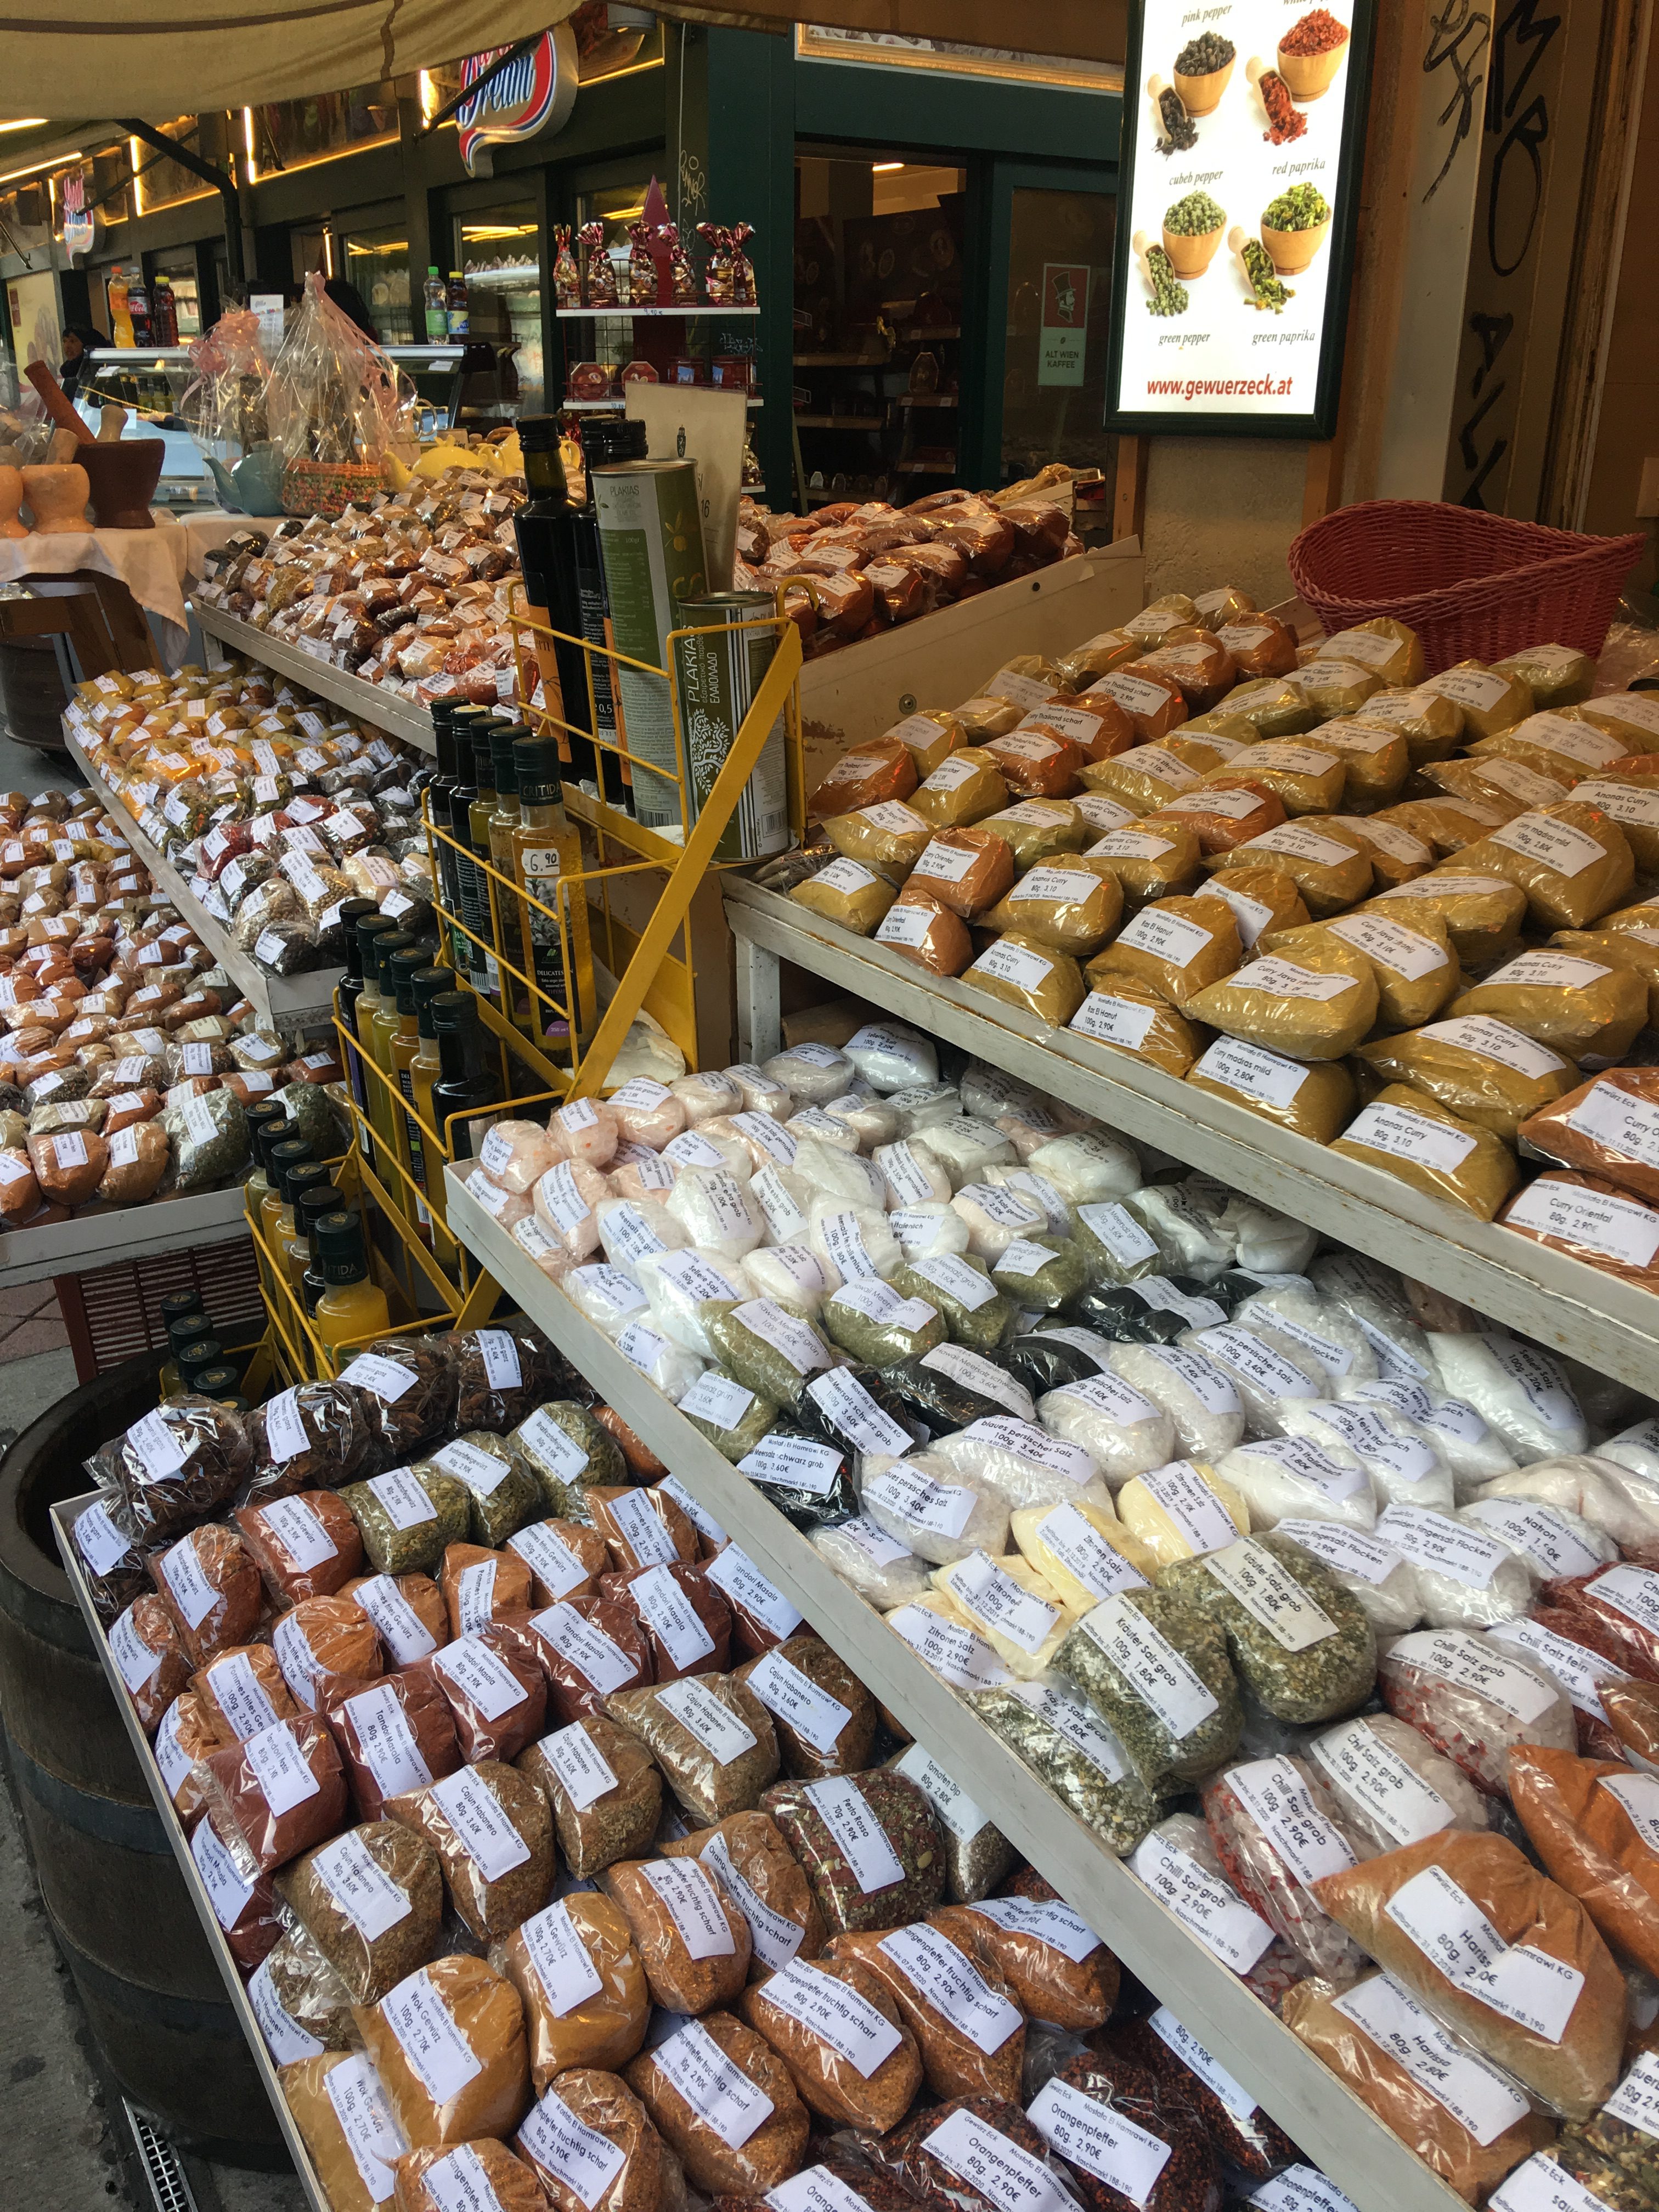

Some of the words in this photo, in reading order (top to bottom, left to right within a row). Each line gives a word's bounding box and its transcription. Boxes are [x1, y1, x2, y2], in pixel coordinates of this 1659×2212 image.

[1182, 10, 1200, 27] pink
[1203, 5, 1232, 22] pepper
[1169, 173, 1192, 185] cubeb
[1194, 170, 1223, 185] pepper
[1273, 162, 1287, 175] red
[1288, 158, 1325, 176] paprika
[1159, 335, 1181, 346] green
[1182, 332, 1210, 346] pepper
[1252, 333, 1277, 346] green
[1279, 329, 1315, 345] paprika
[1147, 374, 1293, 400] www.gewuerzeck.at
[610, 486, 639, 496] PLAKIAS
[1110, 681, 1134, 692] Thailand
[1531, 826, 1554, 842] madras
[1554, 837, 1571, 847] mild
[1135, 930, 1148, 940] 100g.
[1151, 936, 1167, 946] 2,90€
[1141, 920, 1150, 928] Ras
[1155, 924, 1173, 936] Hanut
[990, 949, 1006, 960] Ananas
[1006, 954, 1020, 966] Curry
[1000, 963, 1011, 973] 3,10
[1215, 1060, 1231, 1074] 100g.
[1234, 1069, 1255, 1083] 2,80€
[1227, 1053, 1252, 1069] madras
[1254, 1064, 1272, 1076] mild
[1374, 1116, 1403, 1131] Ananas
[1404, 1126, 1428, 1141] Curry
[1374, 1129, 1389, 1141] 80g.
[1393, 1136, 1413, 1147] 3,10
[1395, 1111, 1420, 1124] Mostafa
[1454, 1134, 1466, 1143] KG
[778, 1202, 791, 1216] grob
[1550, 1198, 1572, 1211] Curry
[1575, 1206, 1613, 1223] Oriental
[1643, 1212, 1657, 1223] KG
[1549, 1212, 1567, 1225] 80g.
[1572, 1219, 1599, 1234] 2,90€
[803, 1336, 820, 1357] grün
[981, 1420, 1008, 1431] blaues
[1008, 1429, 1053, 1452] persisches
[1054, 1447, 1073, 1458] Salz
[995, 1432, 1015, 1446] 100g.
[1020, 1443, 1045, 1458] 3,40€
[755, 1459, 768, 1470] 100g.
[771, 1463, 790, 1473] 3,60€
[808, 1460, 824, 1469] grob
[1423, 1540, 1447, 1554] 2,90€
[1455, 1540, 1492, 1559] Flocken
[648, 1595, 658, 1611] 80g.
[657, 1611, 673, 1630] 2,90€
[652, 1581, 671, 1606] Tandori
[667, 1604, 685, 1632] Masala
[380, 1616, 394, 1634] 2,90€
[393, 1615, 413, 1639] Gewürz
[921, 1607, 934, 1619] Eck
[947, 1624, 969, 1637] Mostafa
[924, 1638, 944, 1655] 100g.
[946, 1650, 970, 1666] 2,90€
[928, 1626, 957, 1645] Zitronen
[957, 1640, 975, 1655] Salz
[1116, 1617, 1143, 1647] Kräuter
[1141, 1645, 1159, 1665] Salz
[1154, 1663, 1177, 1686] grob
[915, 1644, 943, 1662] 31.12.2019
[946, 1661, 980, 1681] Naschmarkt
[1112, 1636, 1132, 1661] 100g.
[1134, 1661, 1158, 1687] 1,80€
[1148, 1630, 1169, 1654] Mostafa
[1197, 1685, 1208, 1698] KG
[1429, 1652, 1454, 1670] 100g.
[1459, 1667, 1491, 1686] 2,90€
[1456, 1649, 1480, 1666] Salz
[1477, 1662, 1506, 1678] grob
[769, 1666, 784, 1683] Cajun
[783, 1679, 811, 1705] Habanero
[769, 1681, 780, 1695] 80g.
[781, 1692, 799, 1709] 3,60€
[831, 1701, 841, 1711] KG
[1156, 1704, 1178, 1730] 188-190
[832, 1804, 843, 1820] 70g.
[842, 1821, 859, 1842] 2,90€
[843, 1798, 856, 1816] Pesto
[854, 1815, 869, 1837] Rosso
[1427, 1867, 1452, 1894] Gewürz
[1450, 1891, 1466, 1907] Eck
[1556, 1965, 1574, 1981] KG
[1437, 1933, 1462, 1965] 80g.
[1459, 1929, 1493, 1968] Hariss
[1421, 1940, 1456, 1977] 31.12.2019
[1510, 2006, 1546, 2032] 188-190
[411, 1990, 423, 2013] Wok
[420, 2010, 441, 2044] Gewürz
[794, 1991, 808, 2005] 80g.
[809, 2001, 832, 2021] 2,90€
[822, 1991, 851, 2018] fruchtig
[848, 2013, 877, 2040] scharf
[400, 2004, 414, 2029] 100g.
[413, 2029, 431, 2055] 2,70€
[804, 2015, 835, 2041] Naschmarkt
[873, 2014, 885, 2027] KG
[1051, 2103, 1119, 2149] Orangenpfeffer
[1115, 2120, 1148, 2144] Hamrawi
[1147, 2140, 1160, 2152] KG
[963, 2116, 988, 2135] Gewürz
[985, 2131, 998, 2142] Eck
[1009, 2147, 1035, 2168] Mostafa
[1053, 2124, 1071, 2143] 80g.
[1075, 2137, 1103, 2161] 2,90€
[924, 2141, 947, 2159] Haltbar
[944, 2154, 955, 2164] bis:
[954, 2162, 985, 2189] 31.10.2020
[968, 2137, 1042, 2199] Orangenpfeffer
[1075, 2154, 1109, 2180] Naschmarkt
[1108, 2174, 1133, 2194] 188-190
[967, 2155, 988, 2176] 80g.
[991, 2175, 1022, 2203] 2,90€
